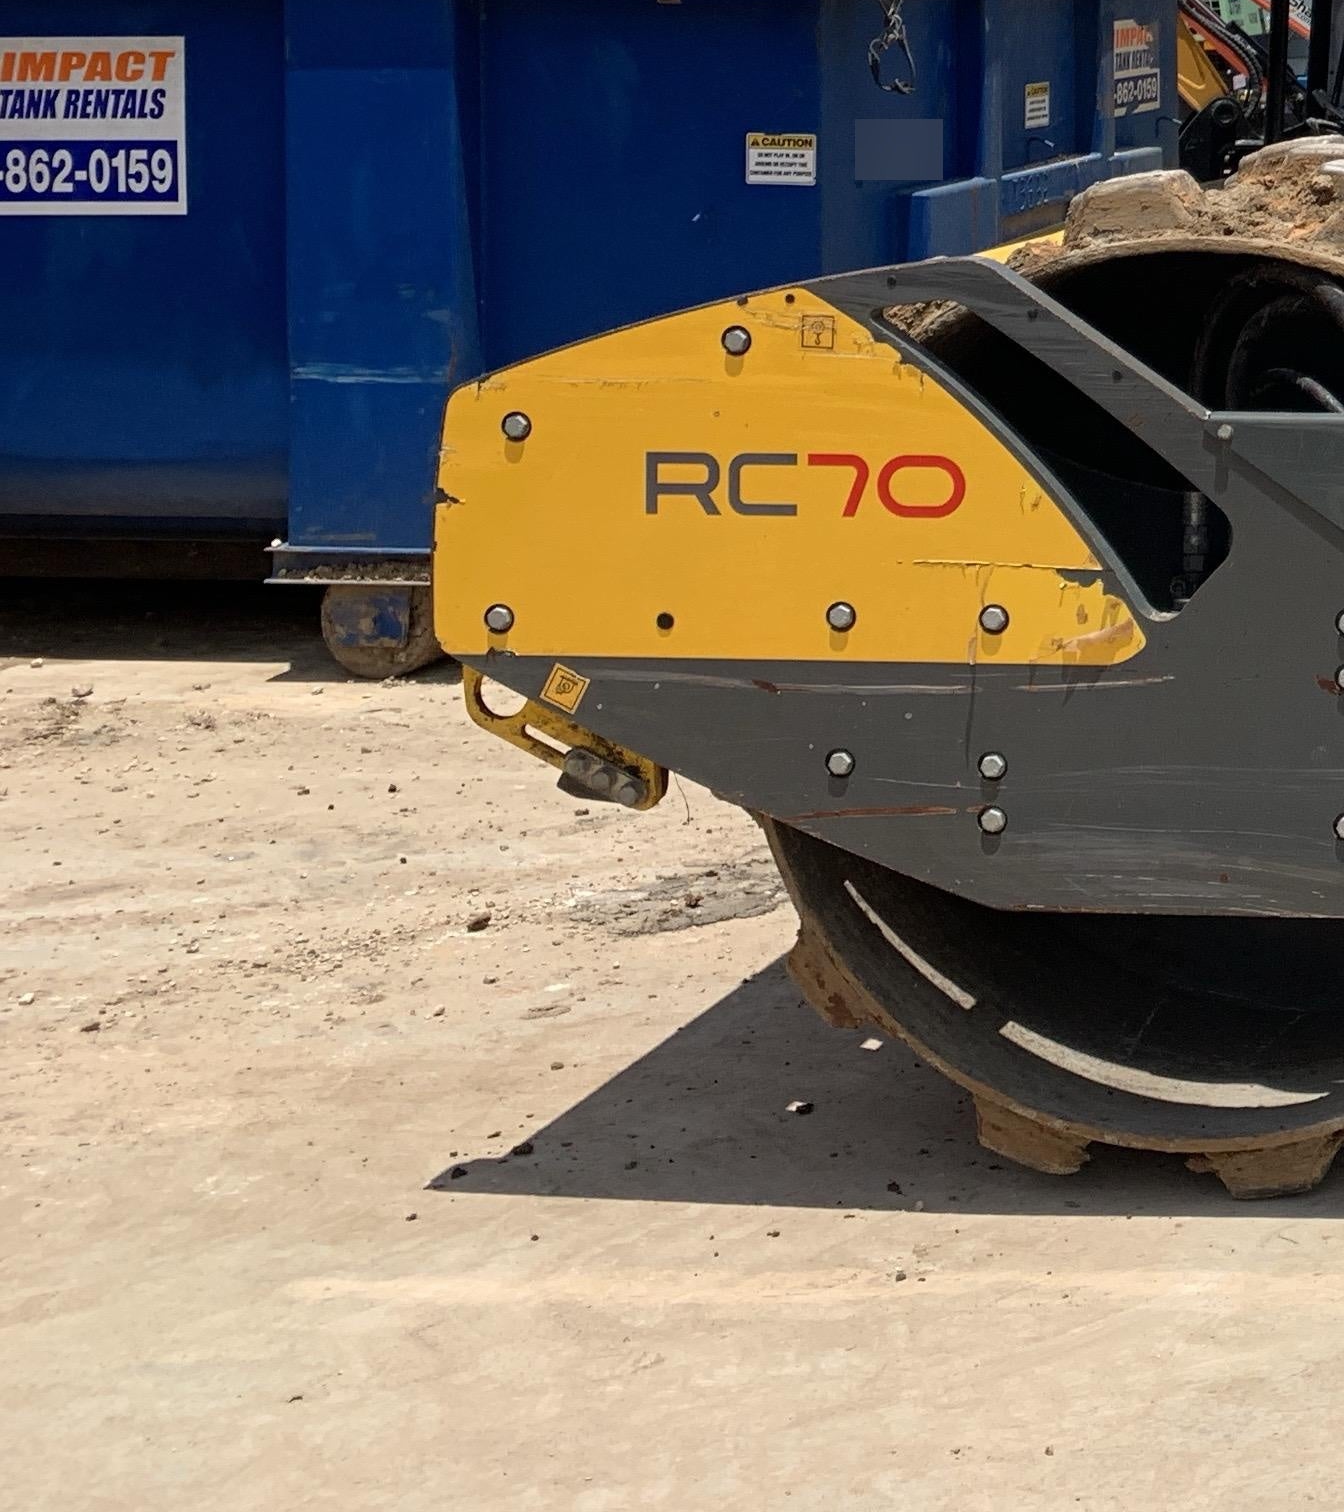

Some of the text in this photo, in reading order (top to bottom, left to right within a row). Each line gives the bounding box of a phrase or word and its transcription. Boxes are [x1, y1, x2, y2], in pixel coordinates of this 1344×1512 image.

[0, 51, 175, 83] IMPACT
[0, 88, 166, 119] TANK RENTALS
[761, 137, 813, 148] CAUTION
[0, 148, 174, 194] 862-0159
[645, 451, 966, 518] RC70
